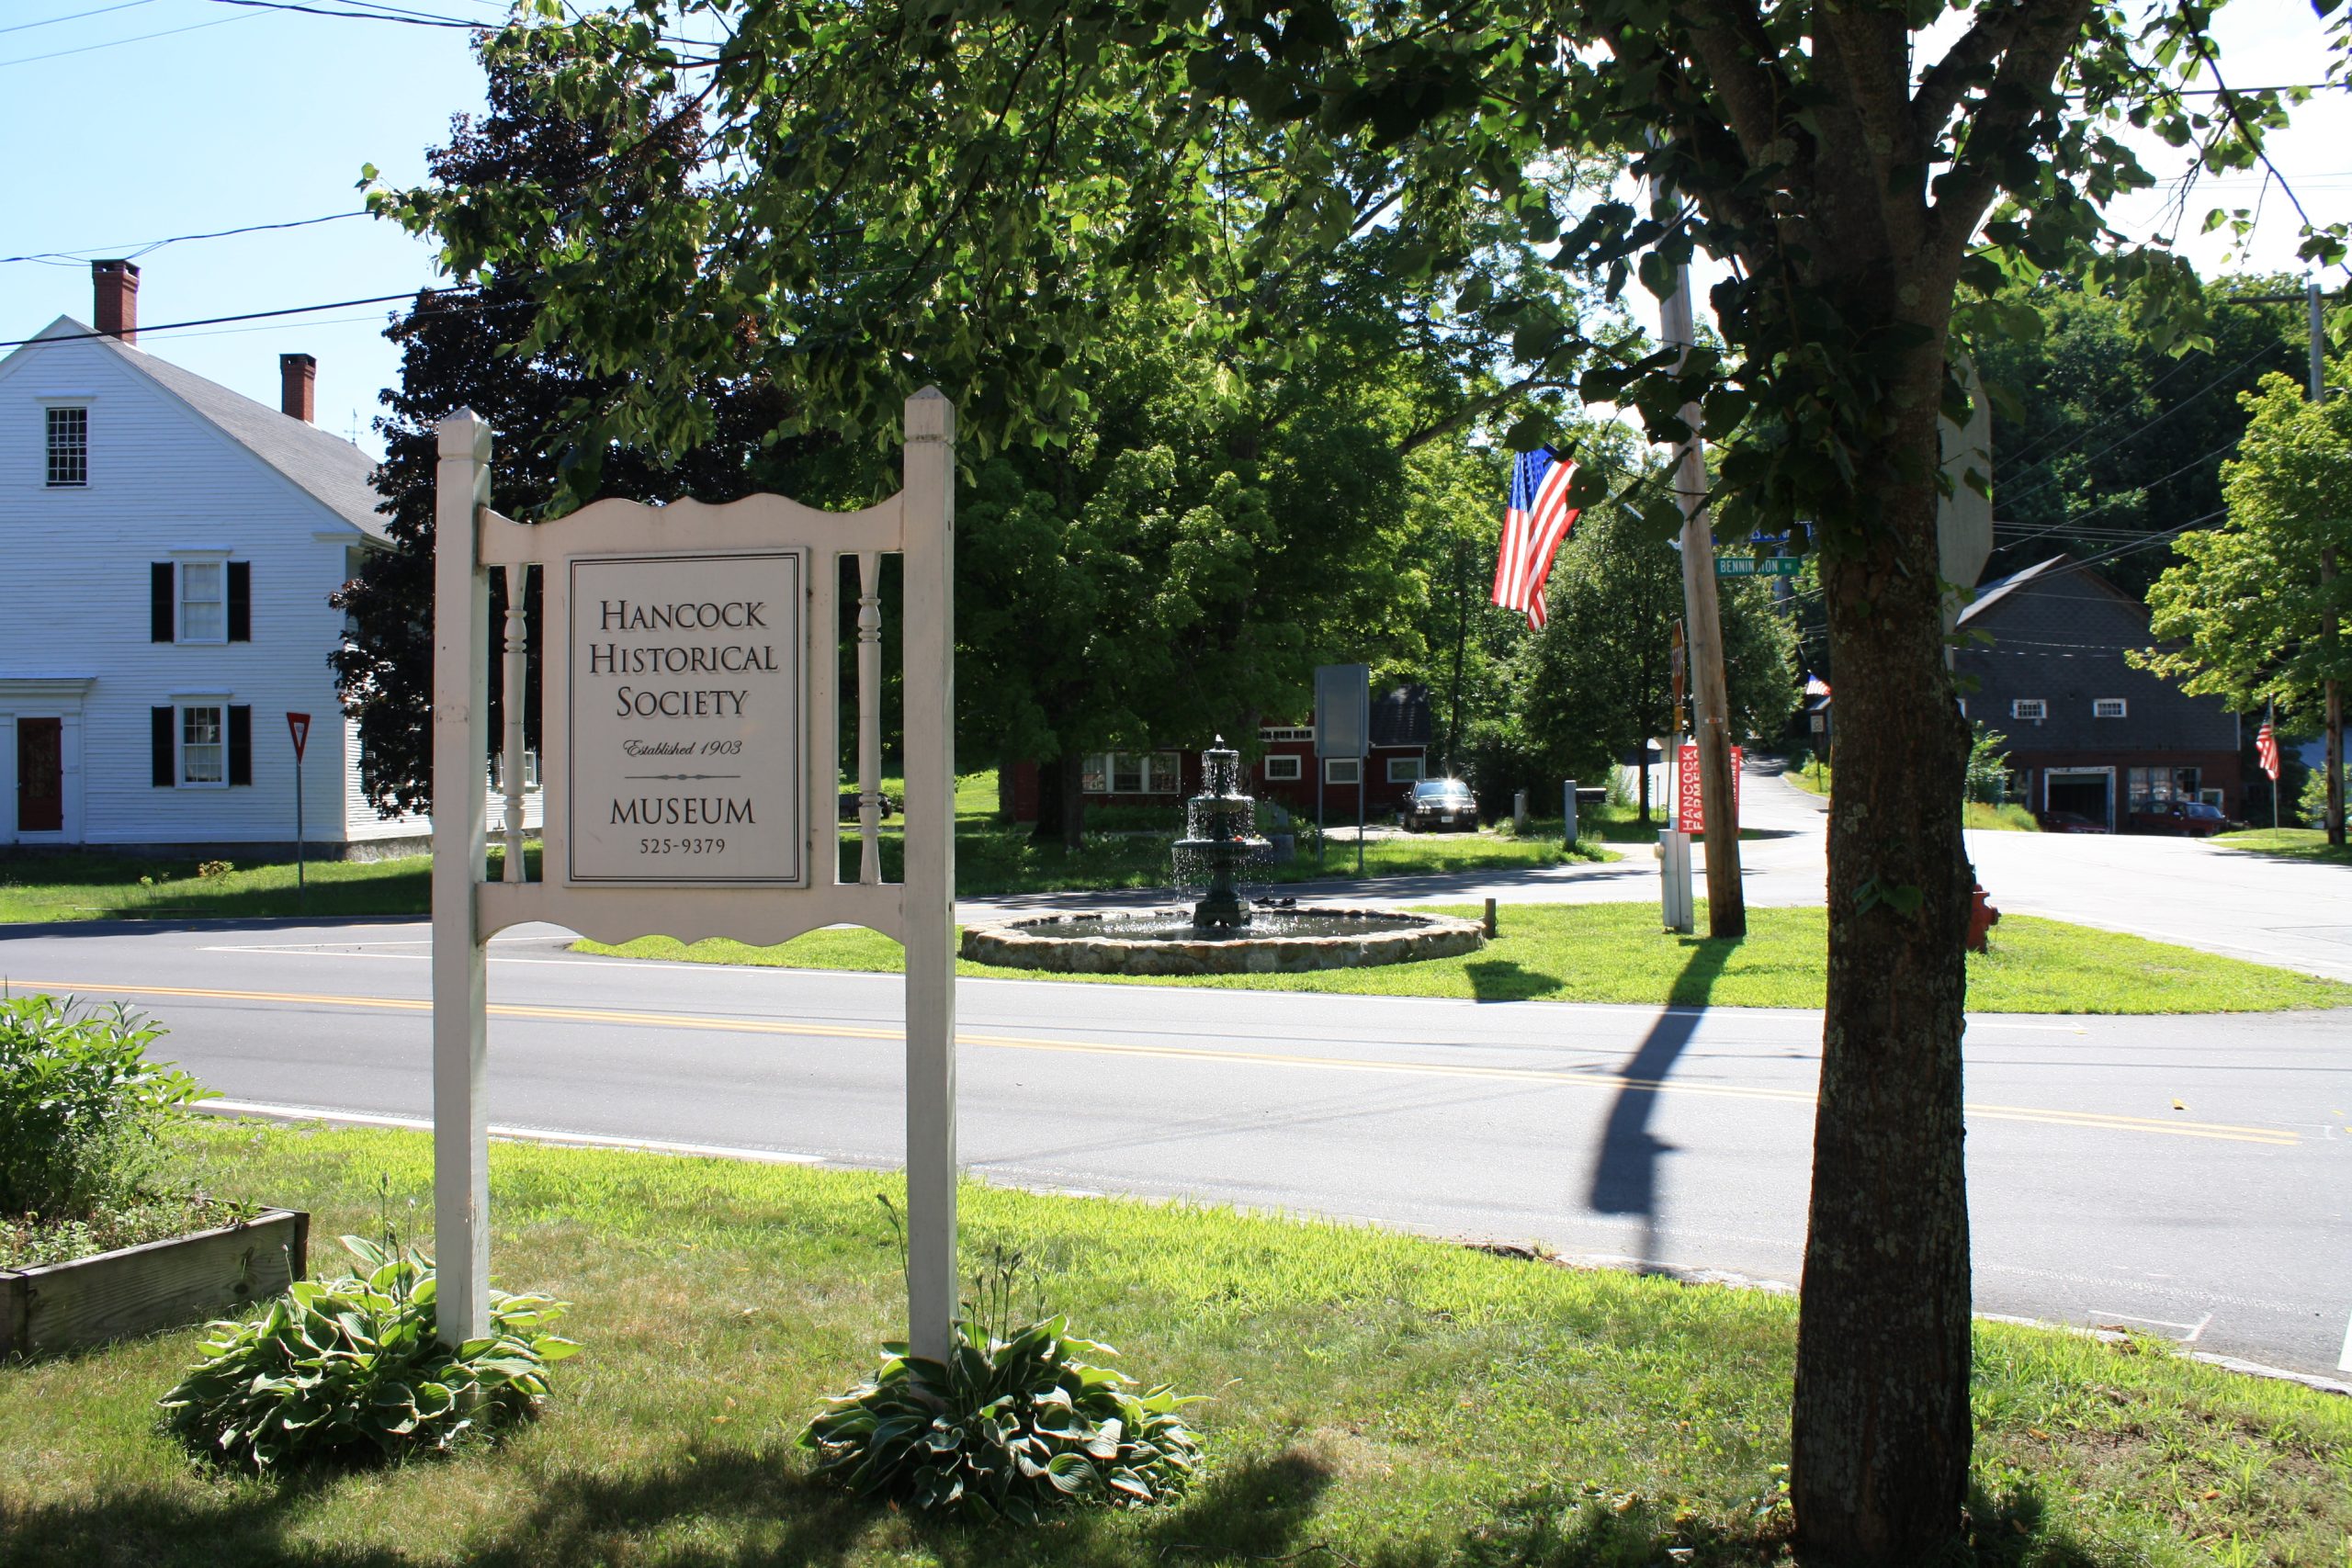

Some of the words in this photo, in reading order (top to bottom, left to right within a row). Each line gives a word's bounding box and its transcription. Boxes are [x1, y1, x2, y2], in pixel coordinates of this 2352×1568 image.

[1720, 559, 1779, 573] BENNINON
[600, 600, 767, 630] HANCOCK
[589, 643, 779, 674] HISTORICAL
[616, 685, 749, 716] SOCIETY
[623, 739, 695, 757] Established
[700, 740, 742, 756] 1903
[1682, 750, 1693, 830] HANCOCK
[610, 797, 756, 825] MUSEUM
[640, 838, 726, 854] 525-9379
